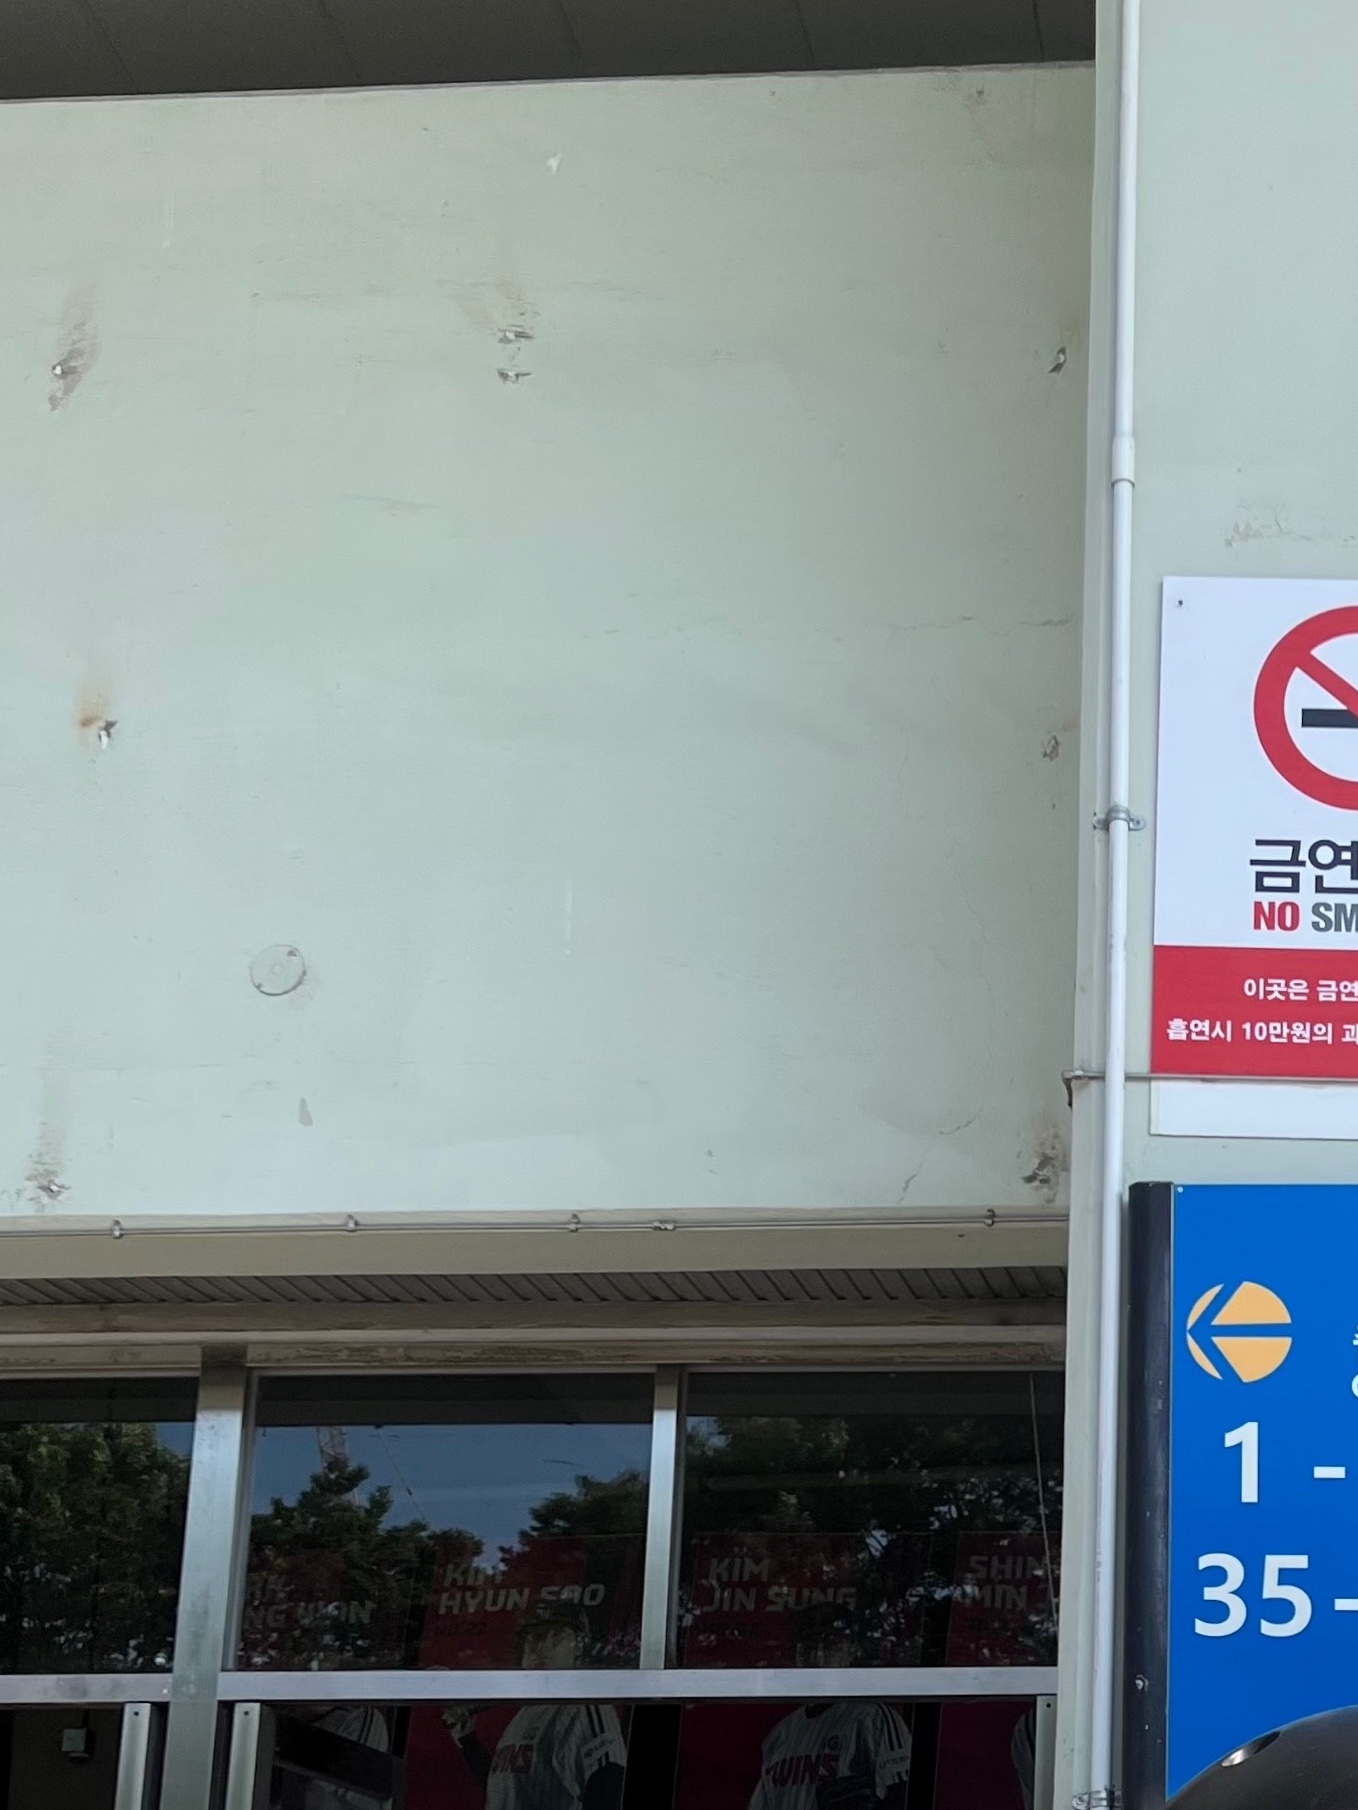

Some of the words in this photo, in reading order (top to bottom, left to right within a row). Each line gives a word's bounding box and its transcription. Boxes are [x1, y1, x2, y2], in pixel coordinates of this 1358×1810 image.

[1253, 901, 1300, 932] NO
[1244, 978, 1310, 1002] 이곳은
[1167, 1019, 1232, 1043] 흡연시
[1242, 1020, 1333, 1045] 10만원의
[1224, 1421, 1259, 1503] 1
[709, 1556, 770, 1582] KIM
